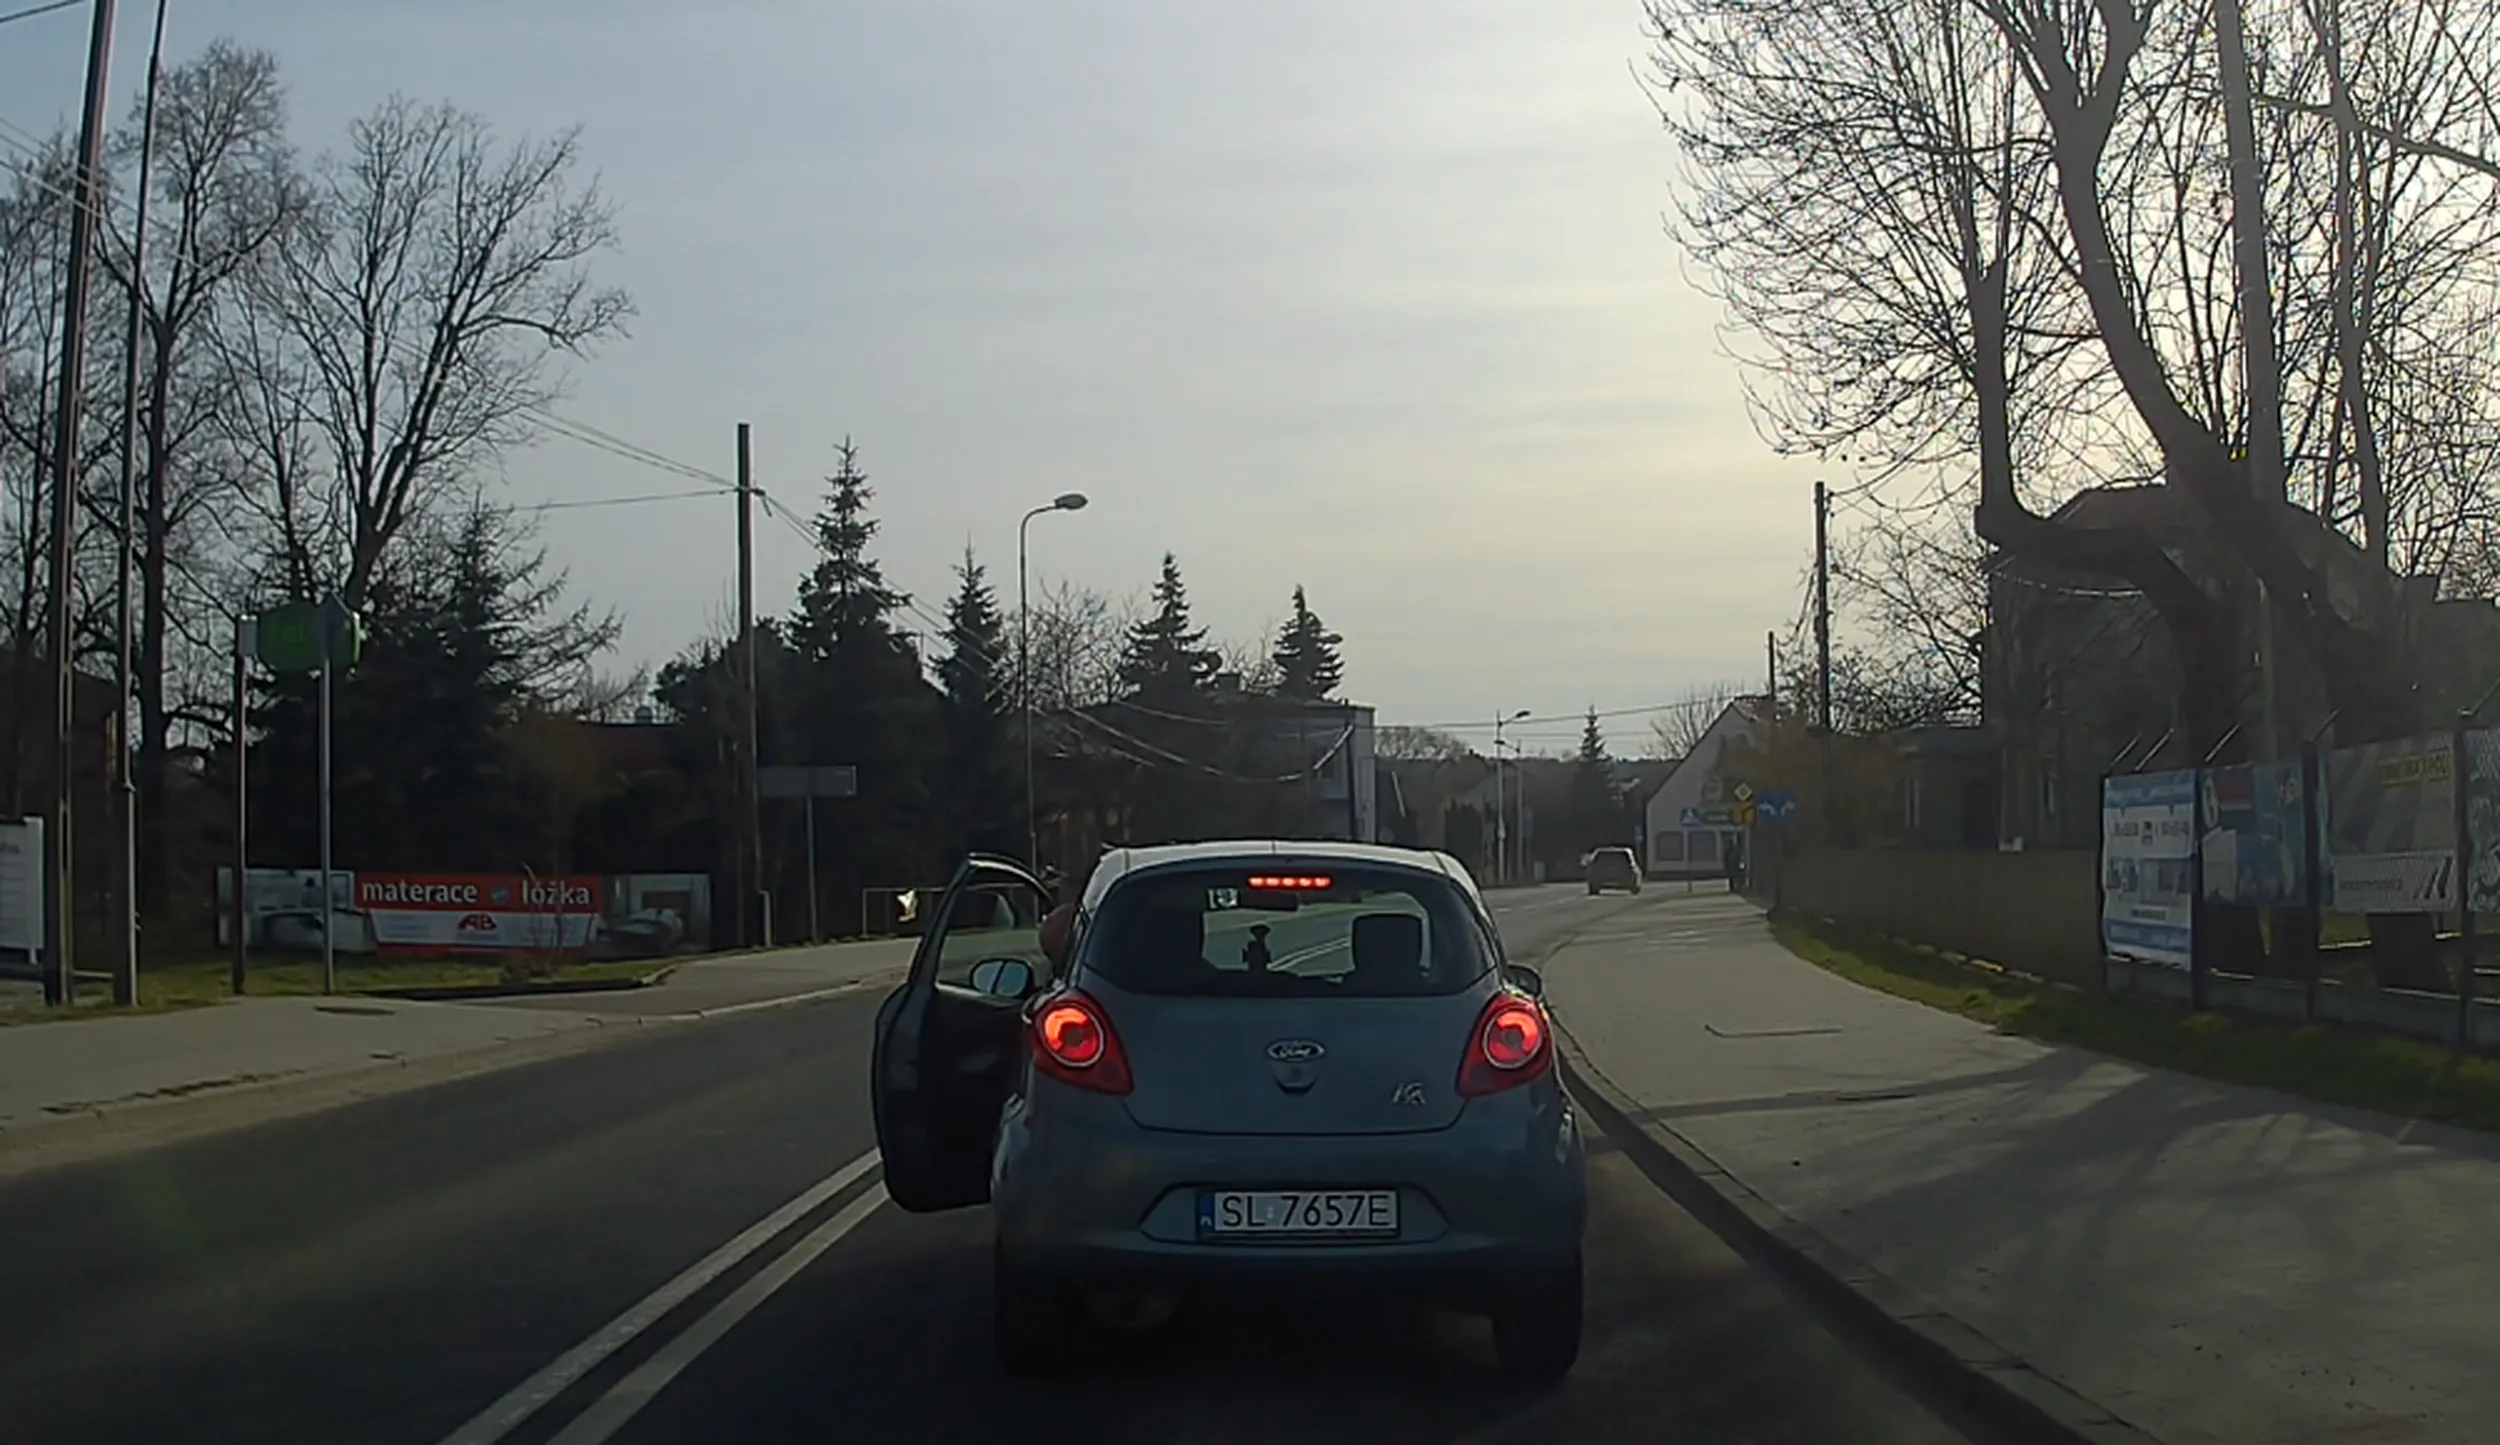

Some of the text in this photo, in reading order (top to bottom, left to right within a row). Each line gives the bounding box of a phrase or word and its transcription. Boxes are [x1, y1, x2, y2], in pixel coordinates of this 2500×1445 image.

[361, 879, 479, 903] materace
[1223, 1195, 1390, 1227] SL 7657E
